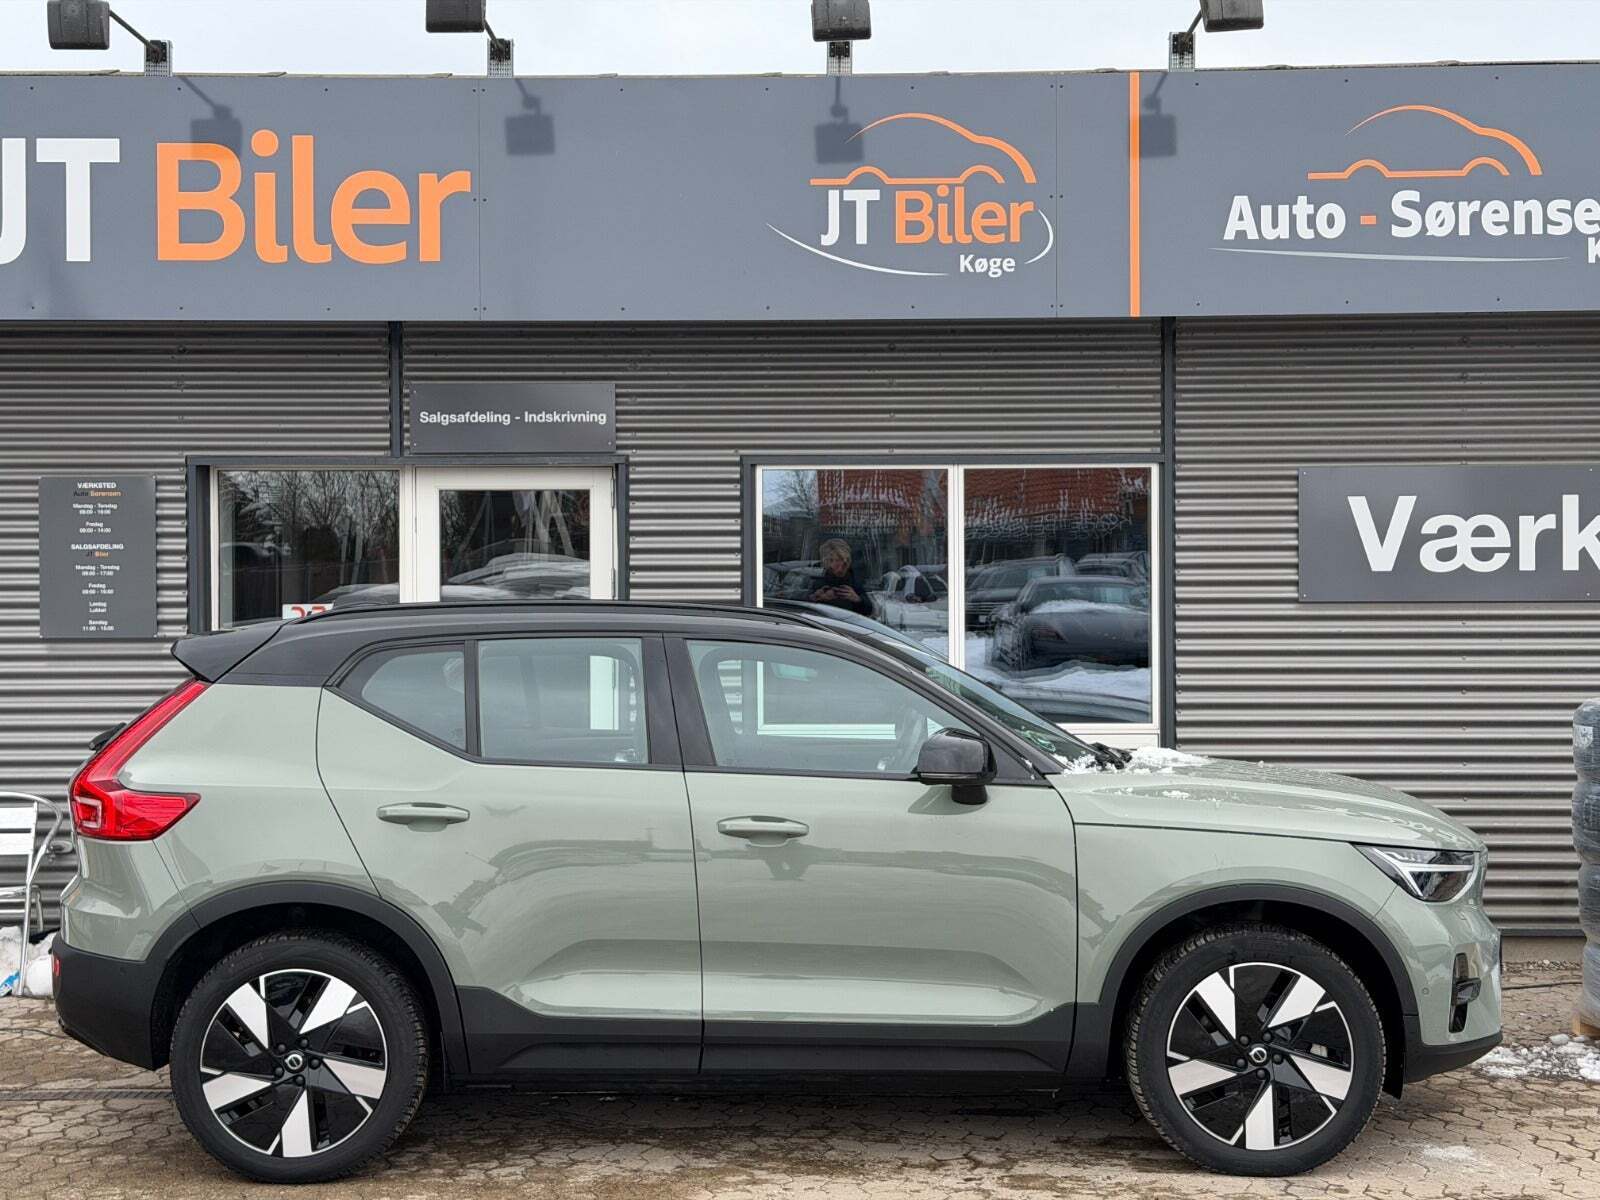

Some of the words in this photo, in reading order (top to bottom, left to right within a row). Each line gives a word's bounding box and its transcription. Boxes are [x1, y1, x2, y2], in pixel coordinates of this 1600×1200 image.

[156, 129, 472, 265] Biler
[820, 189, 881, 247] JT
[895, 184, 1035, 245] Biler
[1223, 195, 1347, 240] Auto
[1390, 190, 1600, 238] Sørense
[959, 254, 1016, 278] Køge
[419, 411, 511, 425] Salgsafdeling
[524, 411, 607, 425] Indskrivning
[1347, 494, 1600, 573] Værk
